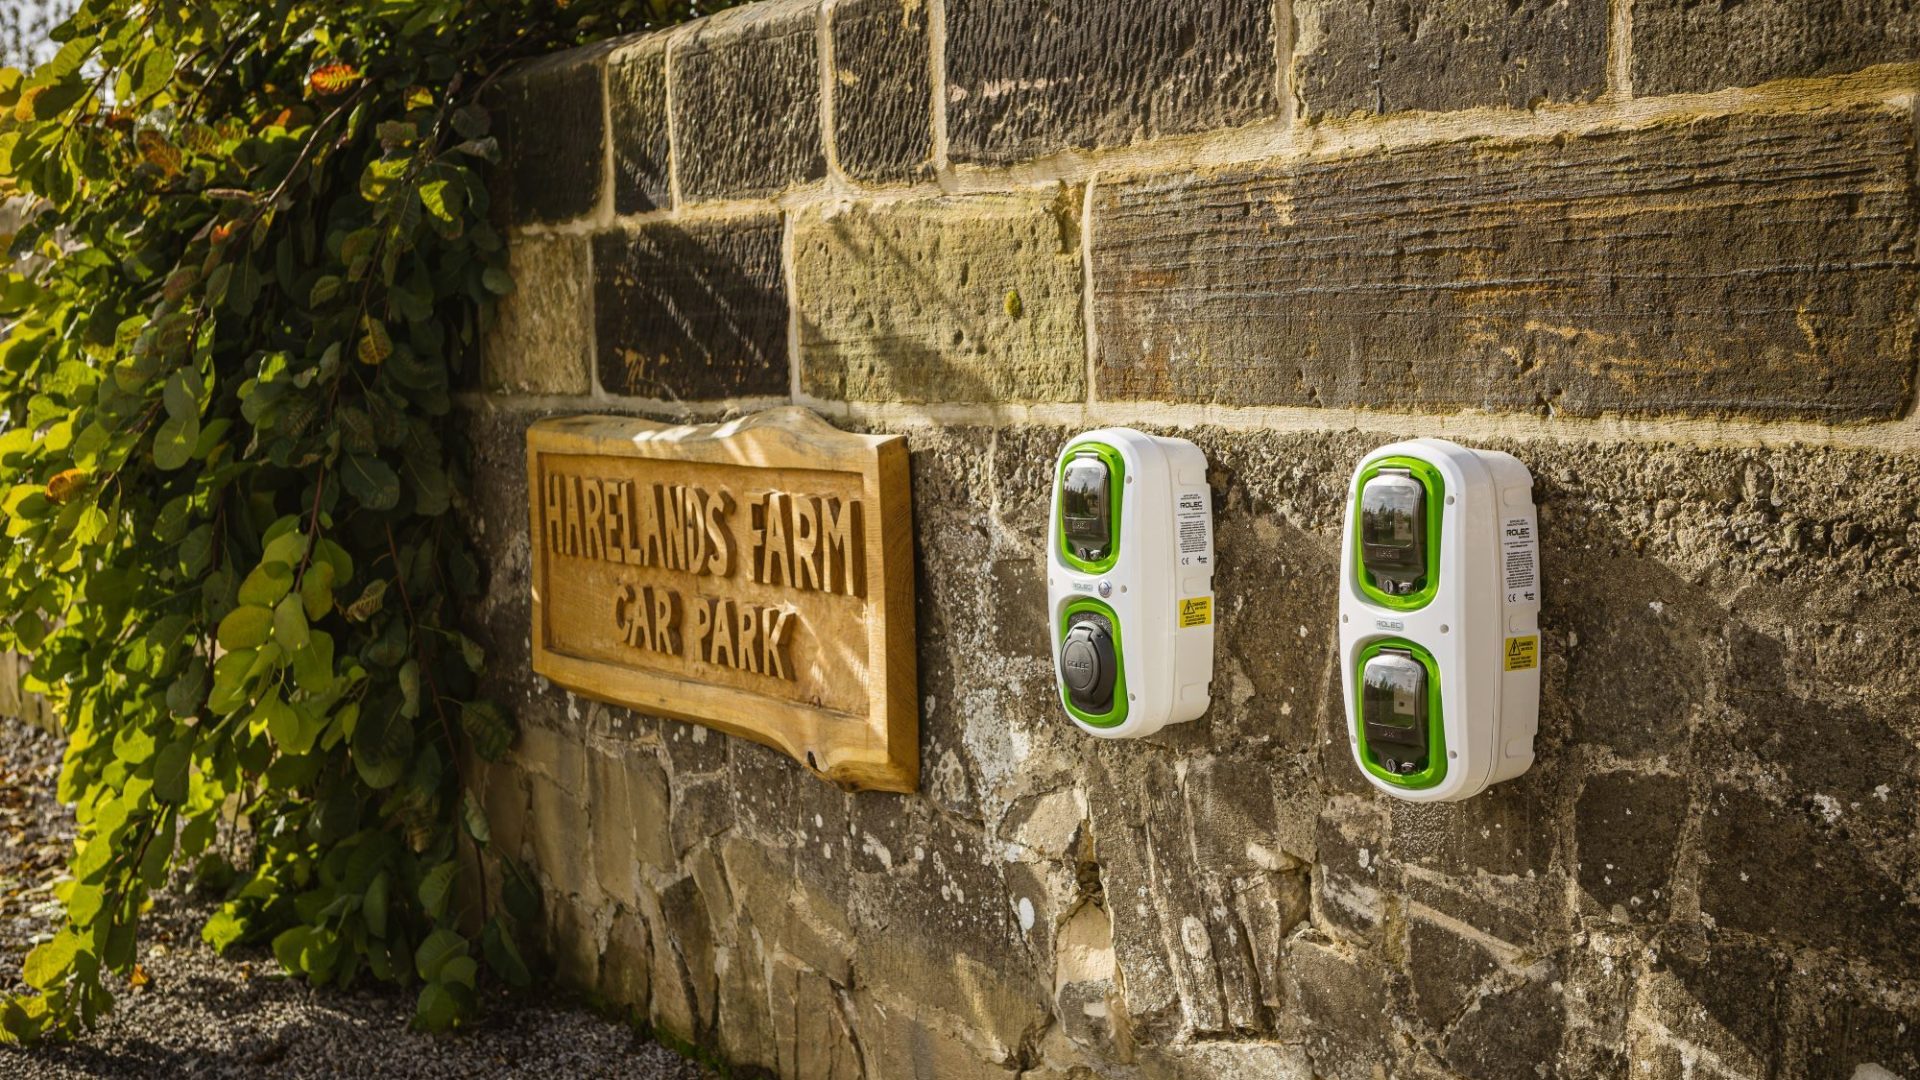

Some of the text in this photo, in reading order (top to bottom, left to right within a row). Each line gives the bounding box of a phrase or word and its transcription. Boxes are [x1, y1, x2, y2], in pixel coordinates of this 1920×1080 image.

[544, 473, 860, 597] HARELANDS FARM
[1506, 527, 1530, 536] ROLEC
[613, 585, 794, 680] CAR PARK
